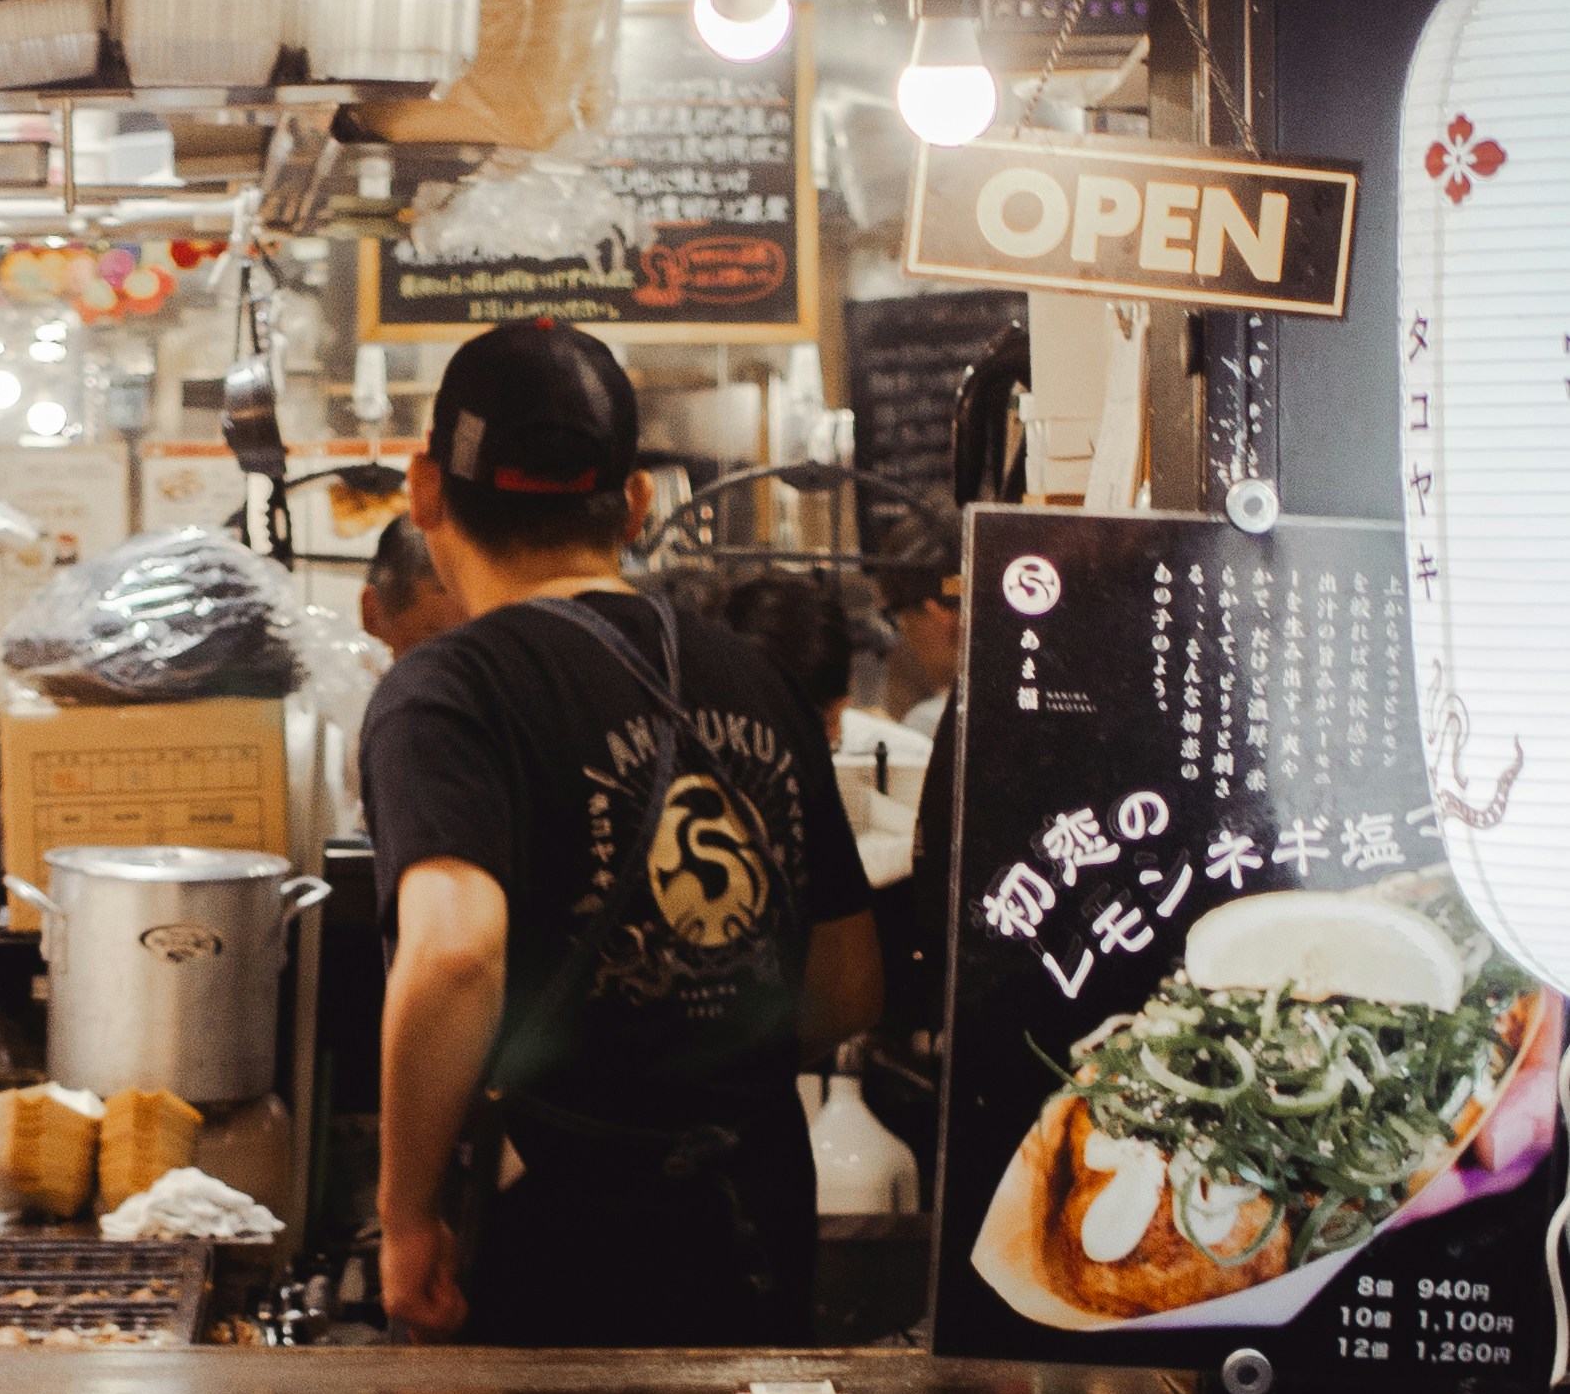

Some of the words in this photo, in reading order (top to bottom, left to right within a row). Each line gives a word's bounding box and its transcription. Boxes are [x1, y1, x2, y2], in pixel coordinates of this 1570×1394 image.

[976, 165, 1289, 284] OPEN
[1408, 308, 1438, 603] タコヤキ
[982, 790, 1170, 939] 初恋の
[1417, 1277, 1490, 1303] 940円
[1418, 1308, 1514, 1335] 1,100円
